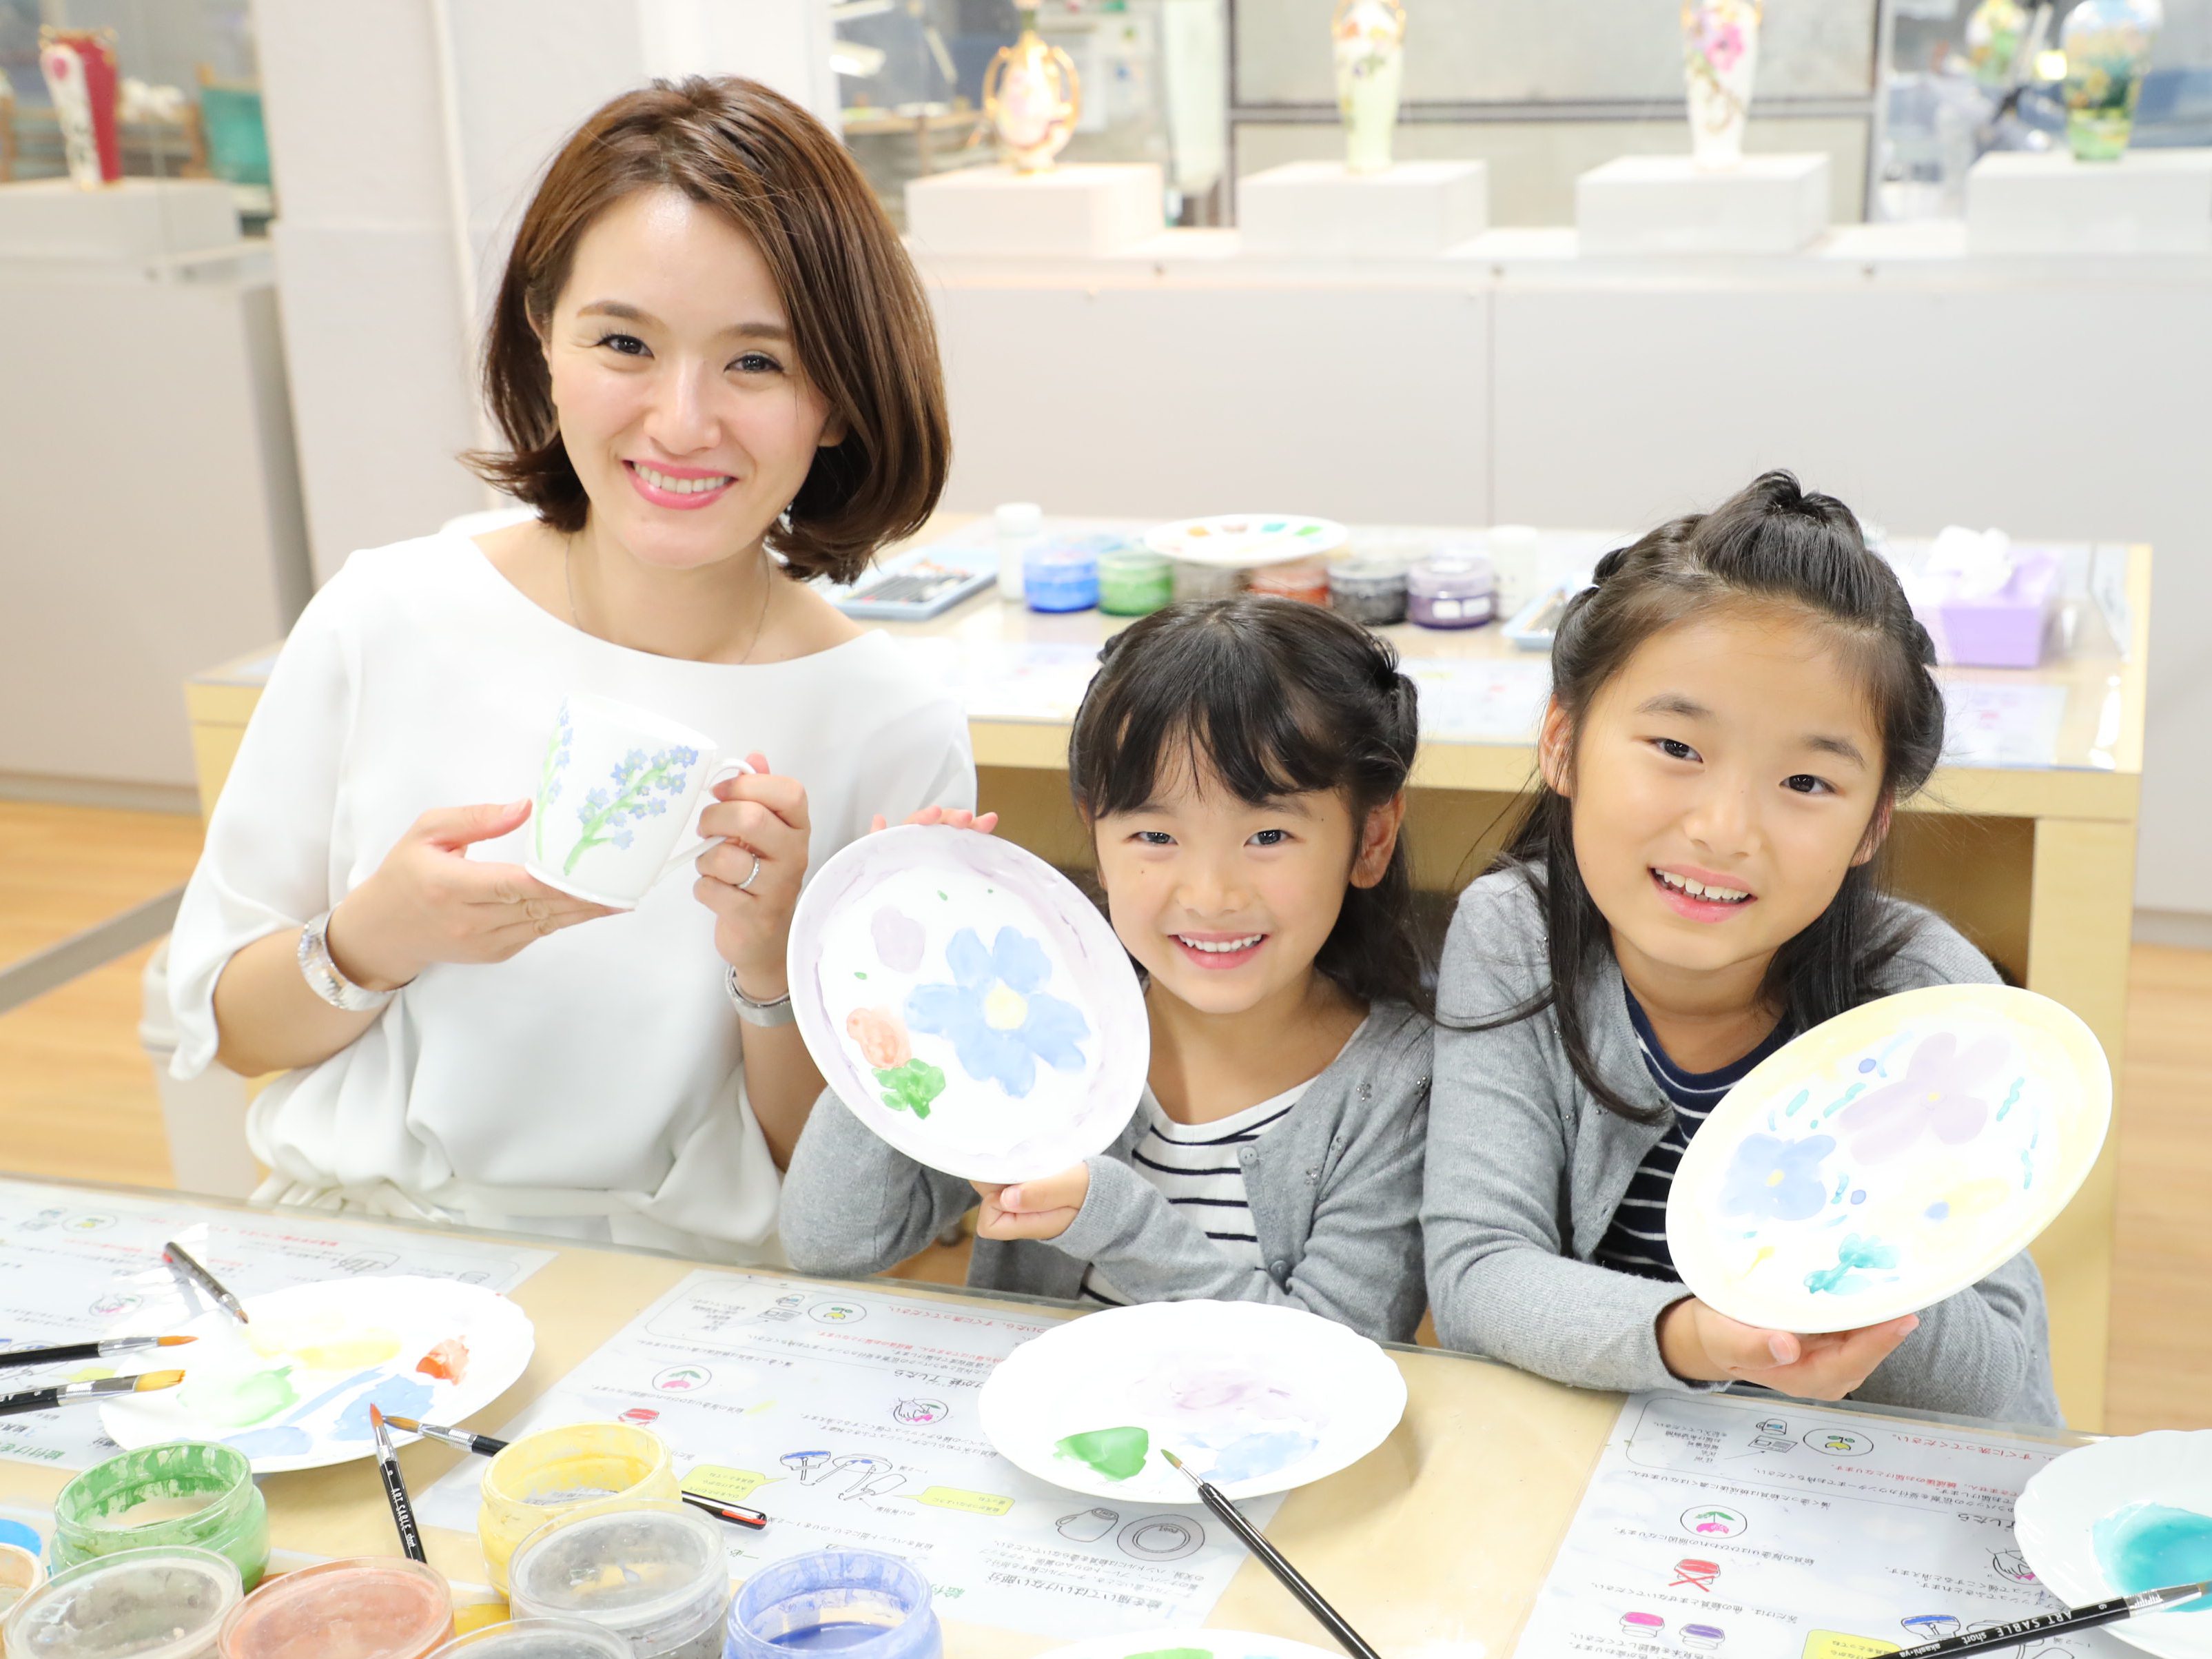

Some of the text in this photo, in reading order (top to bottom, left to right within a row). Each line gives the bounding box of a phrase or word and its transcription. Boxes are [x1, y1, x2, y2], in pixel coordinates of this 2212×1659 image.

[391, 1488, 403, 1503] ART
[396, 1505, 411, 1531] SABLE
[987, 1571, 1163, 1609] 絵を描いてはいけない部分
[2048, 1609, 2073, 1625] ART
[1997, 1617, 2040, 1635] SABLE
[1962, 1630, 1987, 1645] short
